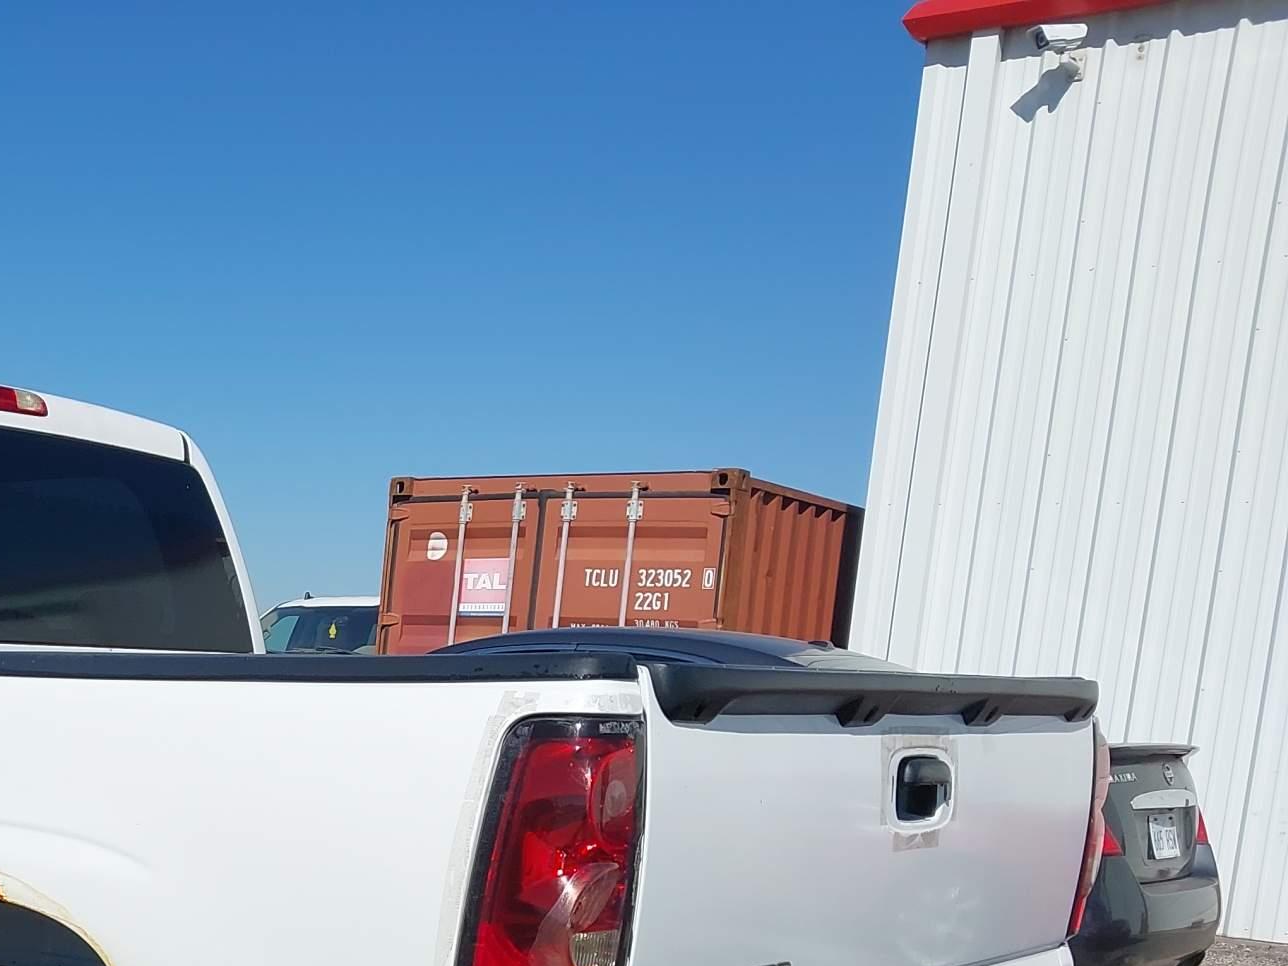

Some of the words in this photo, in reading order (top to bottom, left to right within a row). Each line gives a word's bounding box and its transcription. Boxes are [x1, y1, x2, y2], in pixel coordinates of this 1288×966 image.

[463, 572, 507, 590] TAL
[584, 568, 619, 587] TCLU
[637, 568, 692, 588] 323052
[634, 592, 670, 611] 22G1
